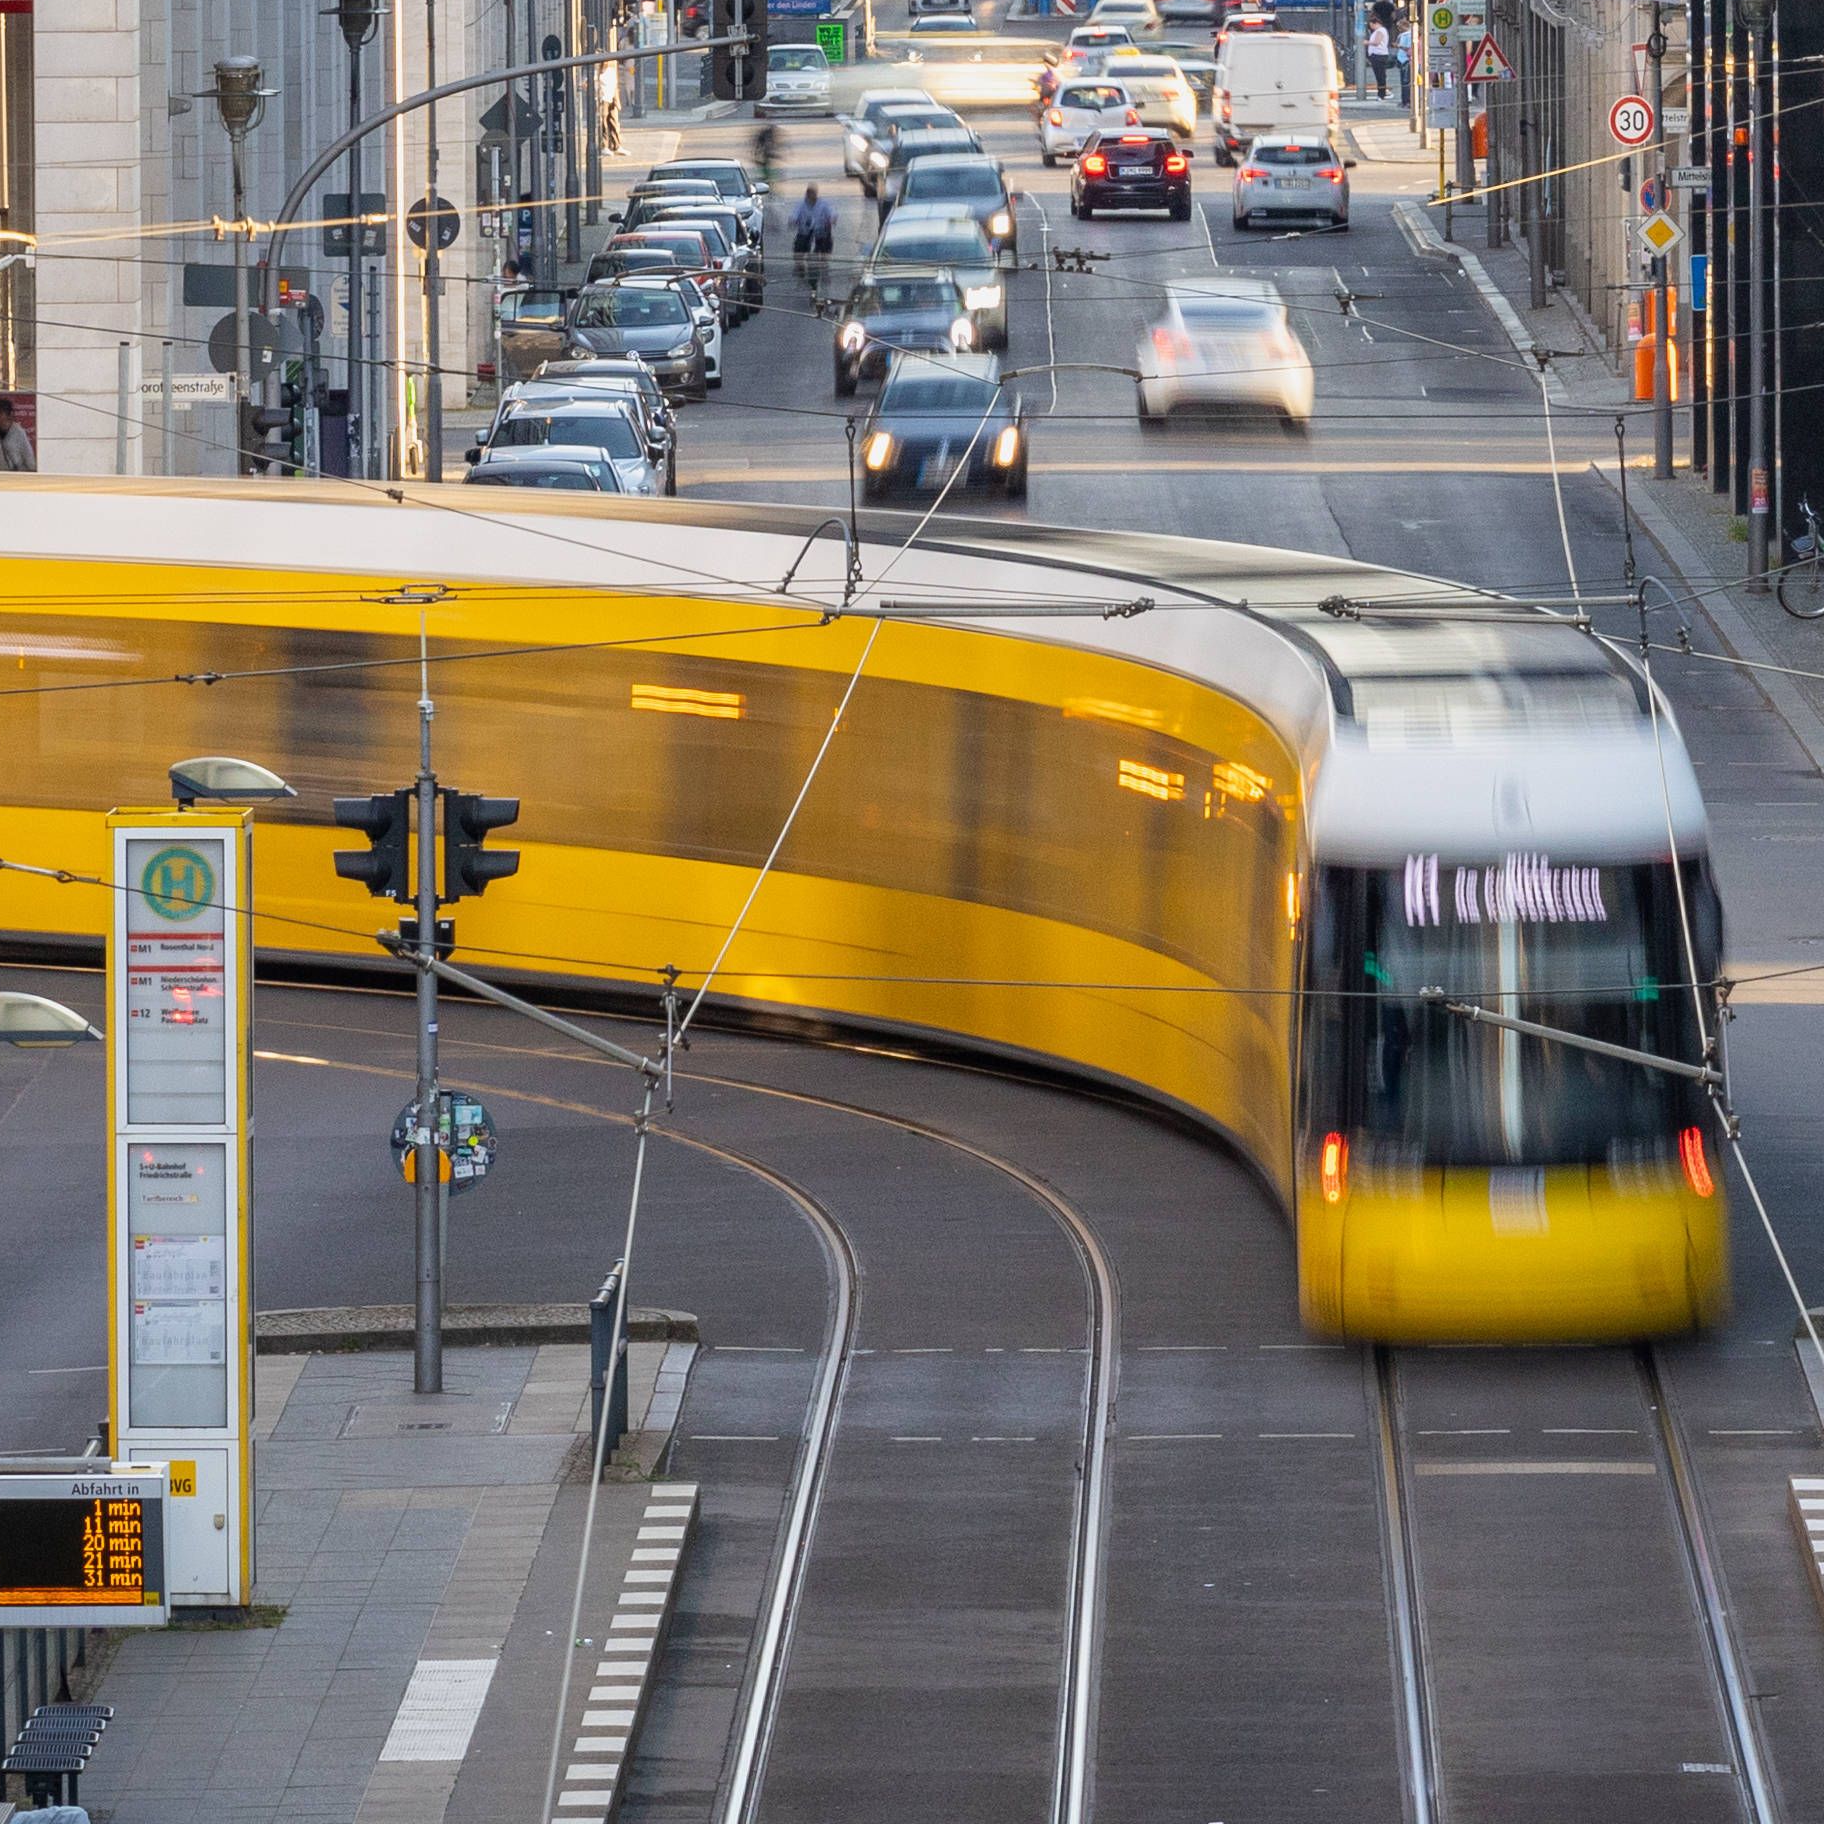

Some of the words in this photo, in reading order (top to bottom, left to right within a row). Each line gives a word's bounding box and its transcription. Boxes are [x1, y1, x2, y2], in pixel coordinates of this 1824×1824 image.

[1619, 110, 1644, 131] 30
[141, 381, 224, 397] oroteenstraße
[138, 944, 152, 953] M1
[138, 977, 152, 986] M1
[71, 1482, 124, 1496] Abfahrt
[127, 1482, 139, 1496] in
[94, 1500, 103, 1516] 1
[108, 1500, 141, 1516] min
[84, 1518, 103, 1534] 11
[109, 1518, 141, 1534] min
[83, 1535, 104, 1551] 20
[109, 1535, 141, 1552] min
[84, 1553, 103, 1569] 21
[110, 1553, 142, 1569] min
[84, 1570, 104, 1587] 31
[110, 1570, 142, 1587] min
